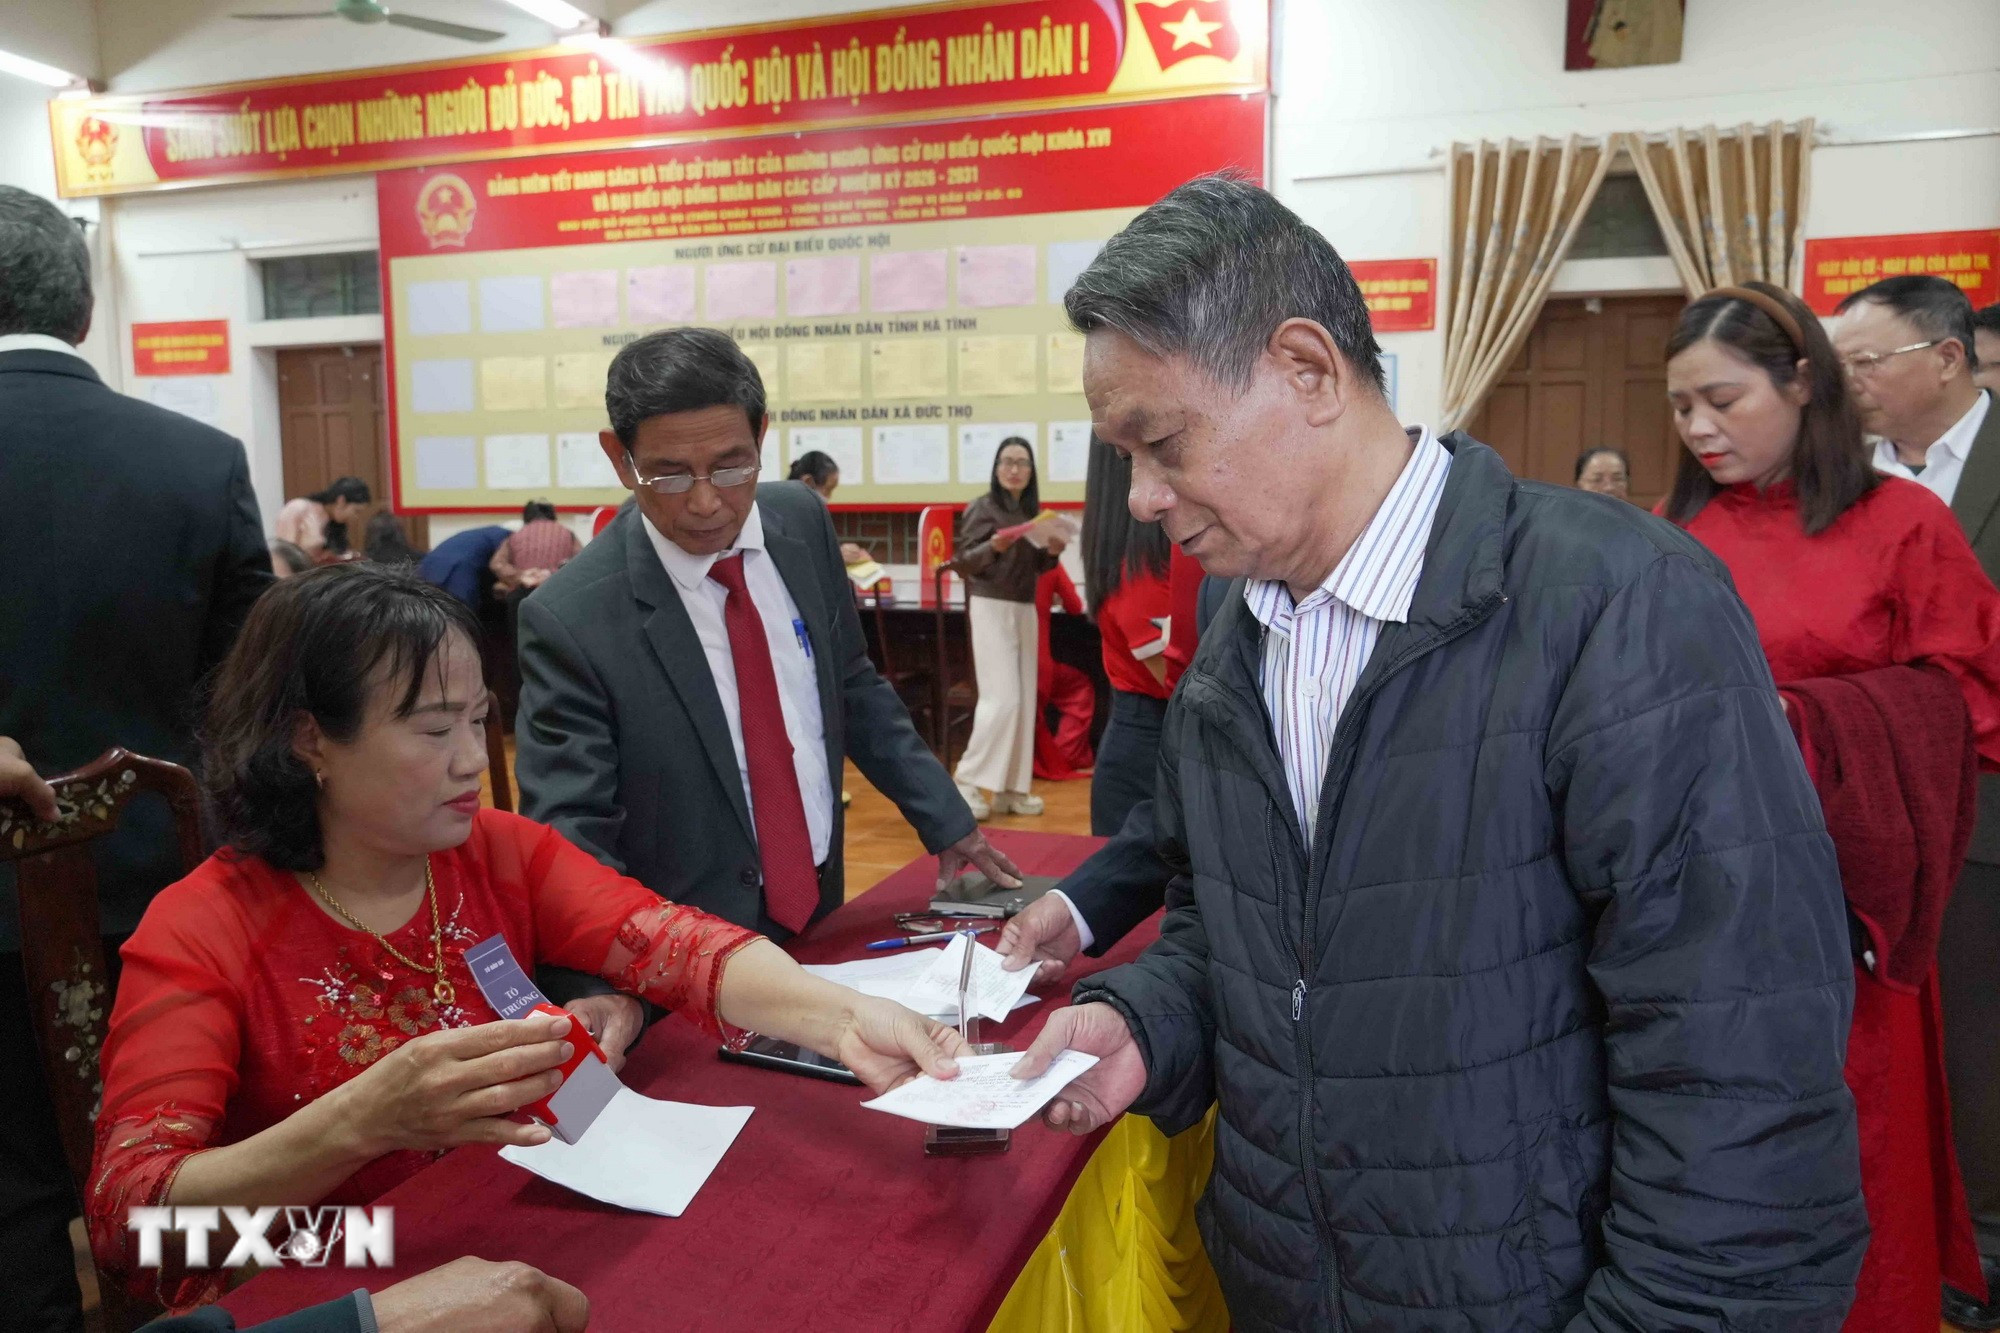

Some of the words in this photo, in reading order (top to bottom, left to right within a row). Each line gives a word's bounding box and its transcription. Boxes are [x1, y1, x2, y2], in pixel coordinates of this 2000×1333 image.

[264, 104, 301, 161] LỰA
[302, 102, 355, 157] CHỌN
[357, 88, 424, 143] NHỮNG
[426, 77, 487, 137] NGƯỜI
[489, 68, 518, 131] ĐỦ
[520, 69, 570, 130] ĐỨC,
[571, 59, 602, 123] ĐỦ
[690, 43, 749, 117] QUỐC
[753, 45, 791, 114] HỘI
[796, 41, 827, 101] VÀ
[831, 36, 870, 107] HỘI
[876, 25, 941, 93] ĐỒNG
[946, 21, 1015, 87] NHÂN
[1020, 15, 1073, 79] DÂN
[1079, 21, 1090, 74] !
[947, 166, 979, 185] 2031
[868, 232, 890, 248] HỘI
[814, 319, 851, 337] NHÂN
[856, 319, 883, 335] DÂN
[781, 407, 816, 422] ĐỒNG
[820, 406, 857, 421] NHÂN
[861, 404, 888, 420] DÂN
[893, 404, 911, 418] XÃ
[915, 403, 942, 418] ĐỨC
[947, 404, 973, 419] THỌ
[504, 987, 519, 1000] TỔ
